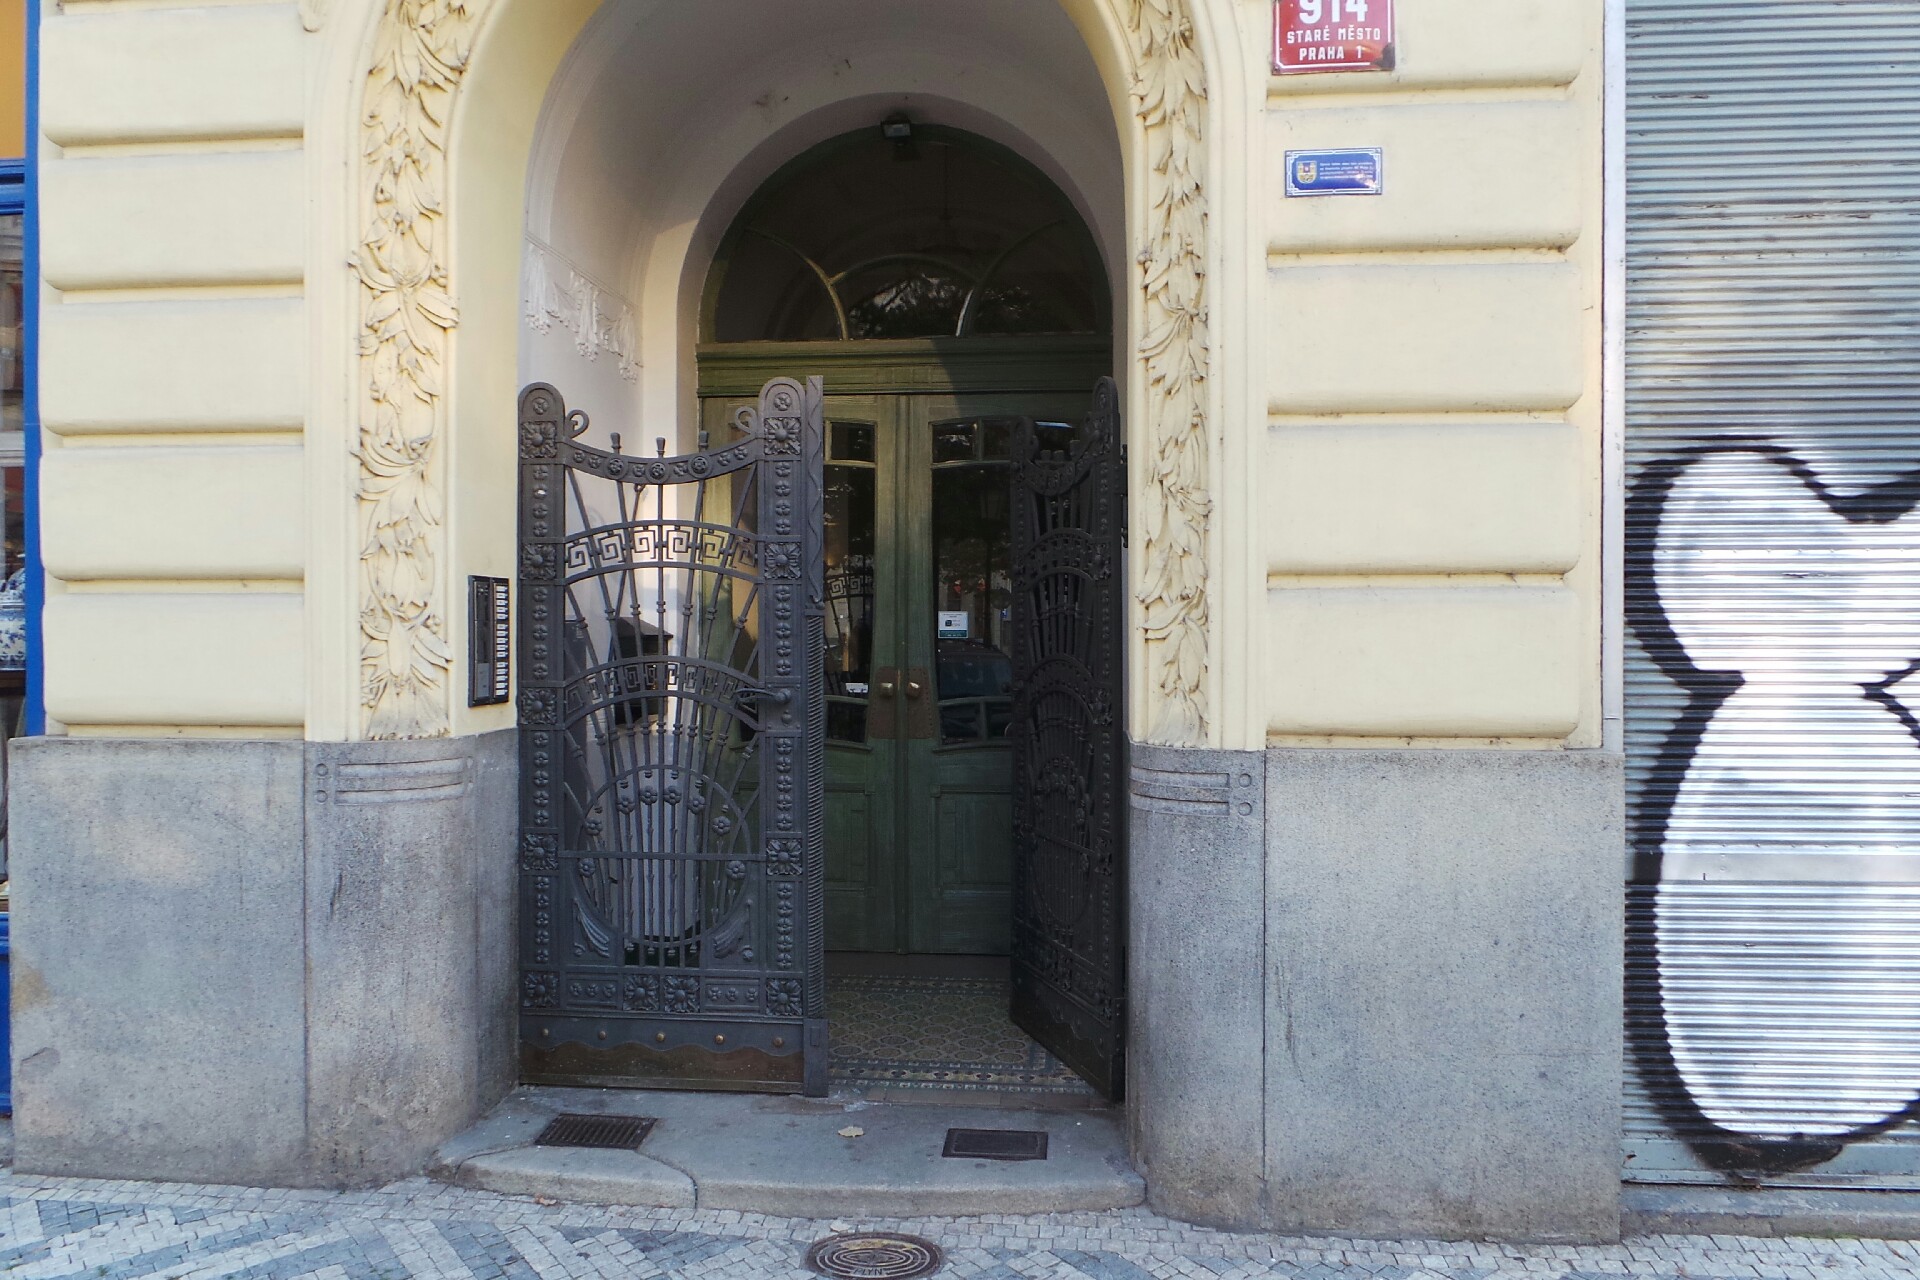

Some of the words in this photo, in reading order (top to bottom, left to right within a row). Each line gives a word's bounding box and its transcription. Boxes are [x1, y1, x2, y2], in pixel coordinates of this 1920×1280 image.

[1299, 0, 1368, 24] 914
[1287, 25, 1330, 44] STARÉ
[1338, 24, 1380, 41] MĚSTO
[1299, 46, 1344, 61] PRAHA
[1356, 45, 1362, 58] 1
